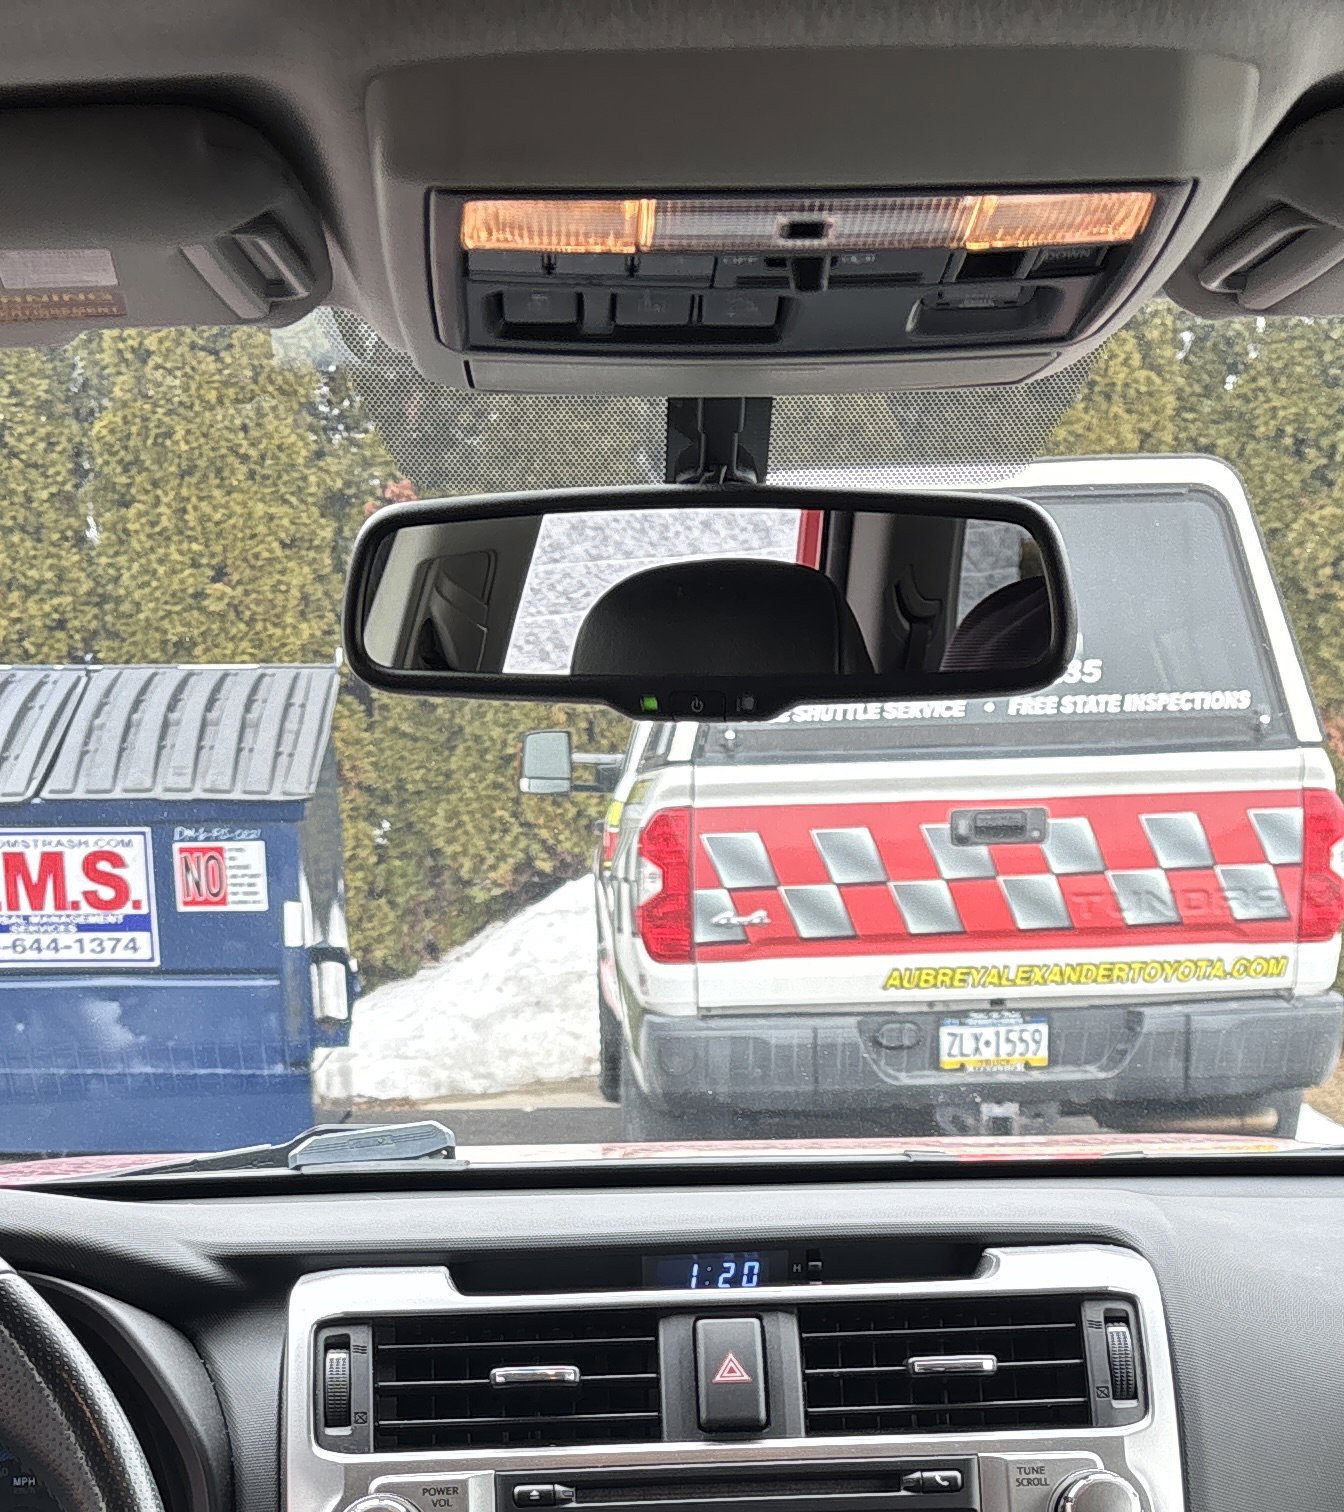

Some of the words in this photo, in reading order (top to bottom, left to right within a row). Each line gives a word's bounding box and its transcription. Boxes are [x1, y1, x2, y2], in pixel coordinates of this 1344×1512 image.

[793, 703, 881, 722] SHUTTLE
[884, 700, 966, 719] SERVICE
[1008, 696, 1059, 716] FREE
[1060, 694, 1122, 714] STATE
[1125, 690, 1252, 712] INSPECTIONS
[179, 851, 226, 902] NO
[883, 956, 1290, 991] AUBREYALEXANDERTOYOTA.COM
[691, 1260, 760, 1289] 1:20
[1017, 1466, 1046, 1475] TUNE
[12, 1477, 36, 1487] MPH
[1016, 1477, 1050, 1487] SCROLL
[422, 1487, 459, 1497] POWER
[431, 1498, 453, 1508] VOL
